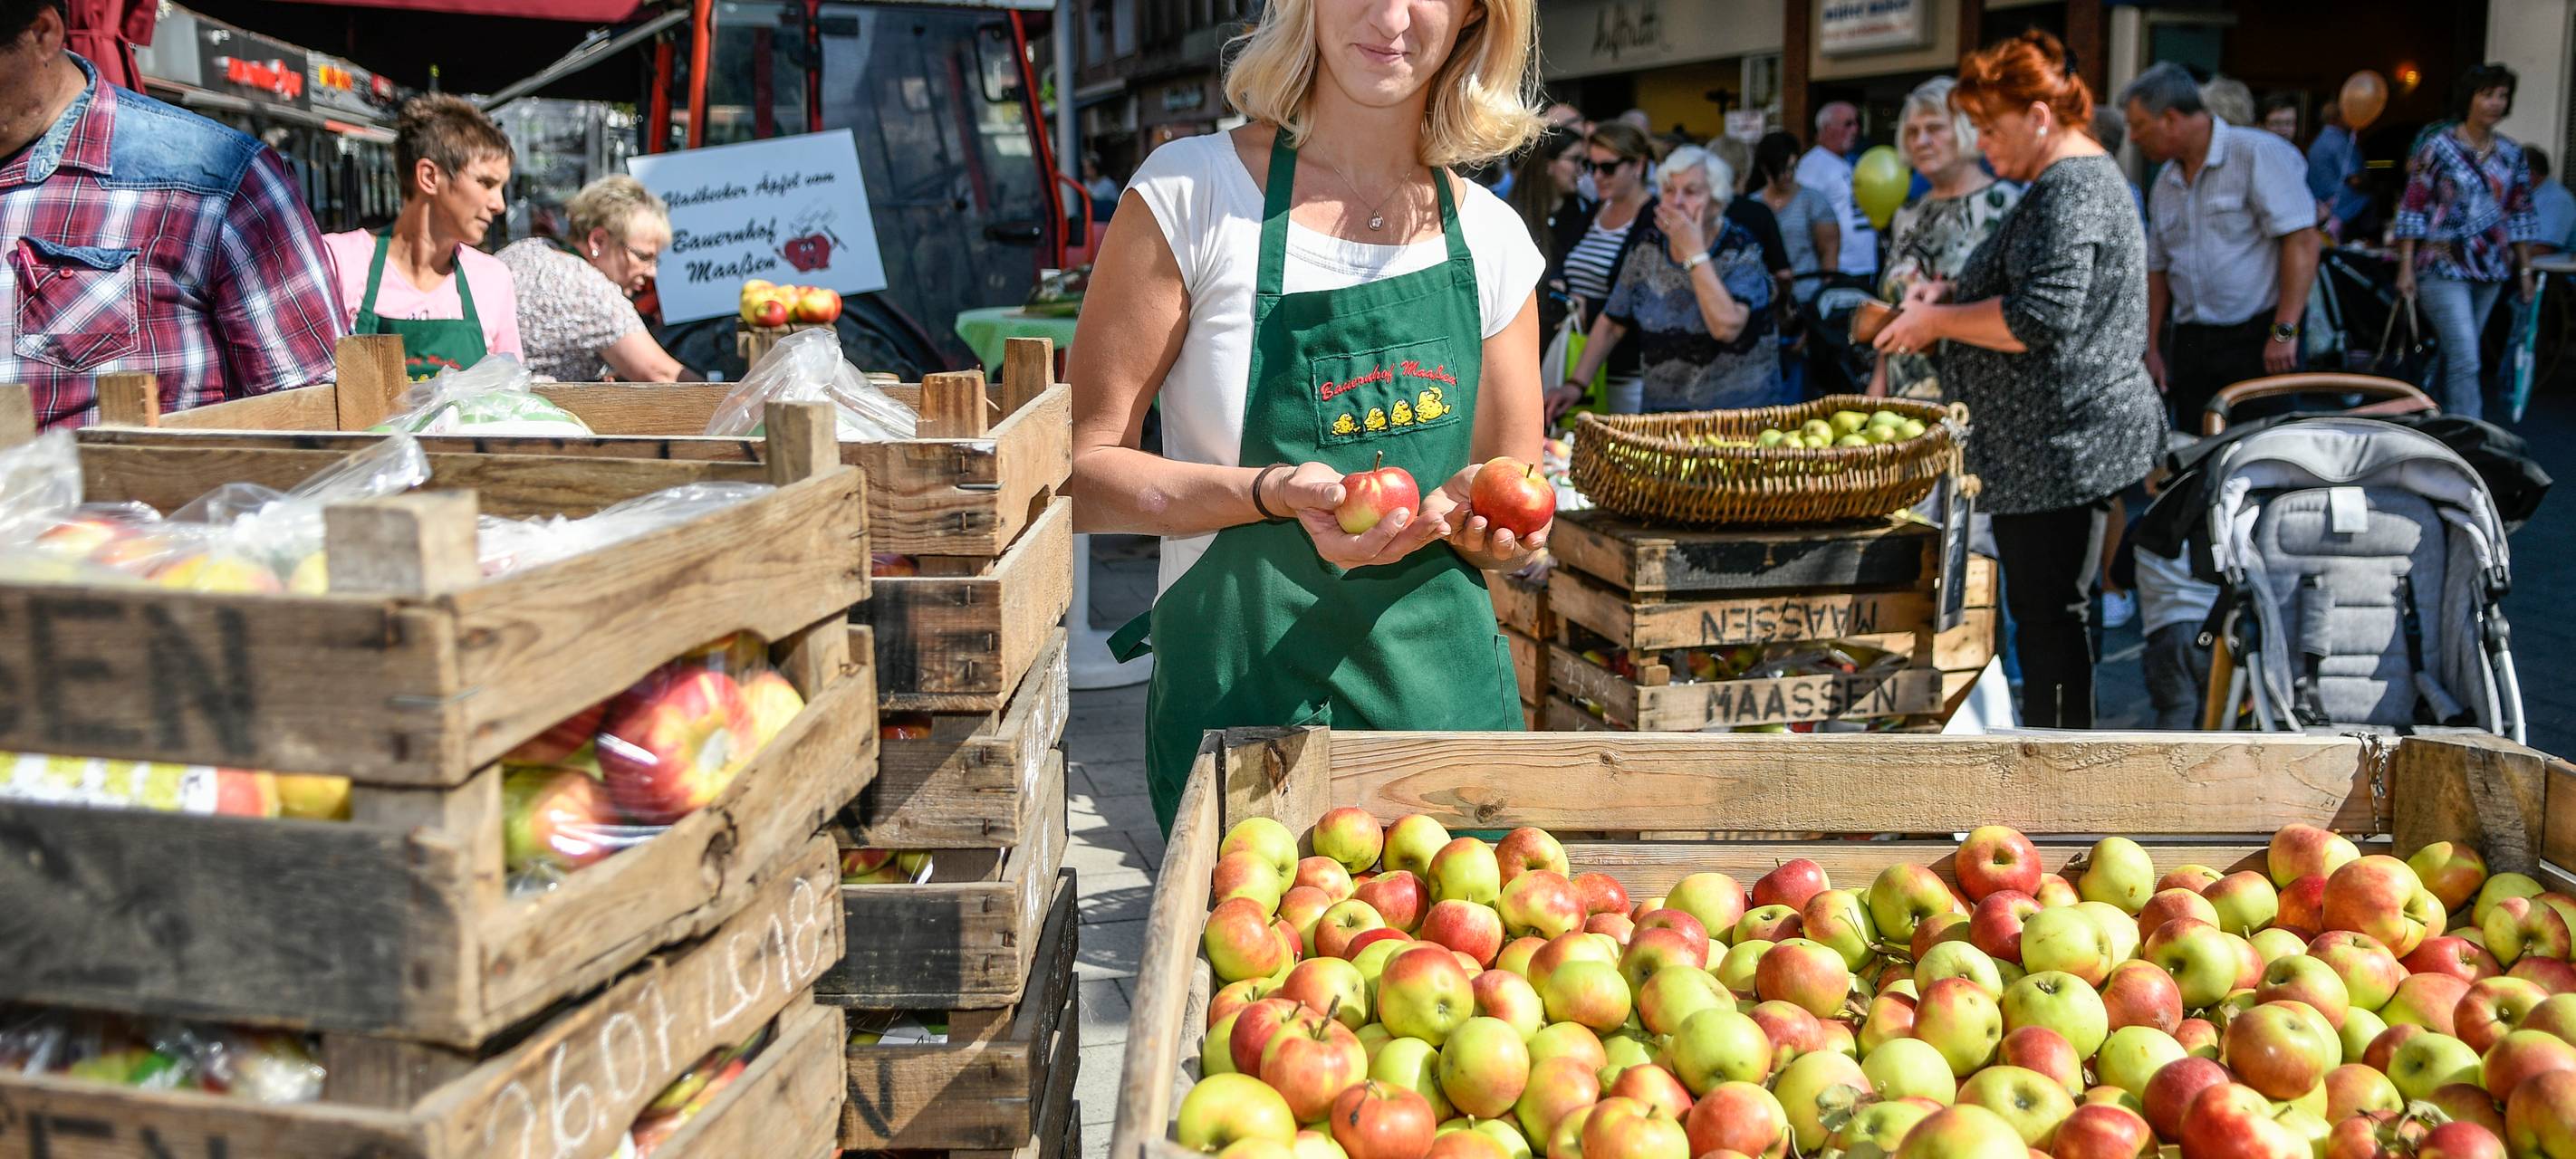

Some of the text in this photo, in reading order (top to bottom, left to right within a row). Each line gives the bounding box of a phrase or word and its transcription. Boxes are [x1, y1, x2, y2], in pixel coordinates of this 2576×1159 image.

[672, 216, 777, 254] Bauernhof
[685, 251, 777, 283] Maaßen
[1319, 359, 1457, 401] Bauernhof Maaßen
[1700, 599, 1877, 646] MAASSEN
[1705, 675, 1898, 723] MAASSEN
